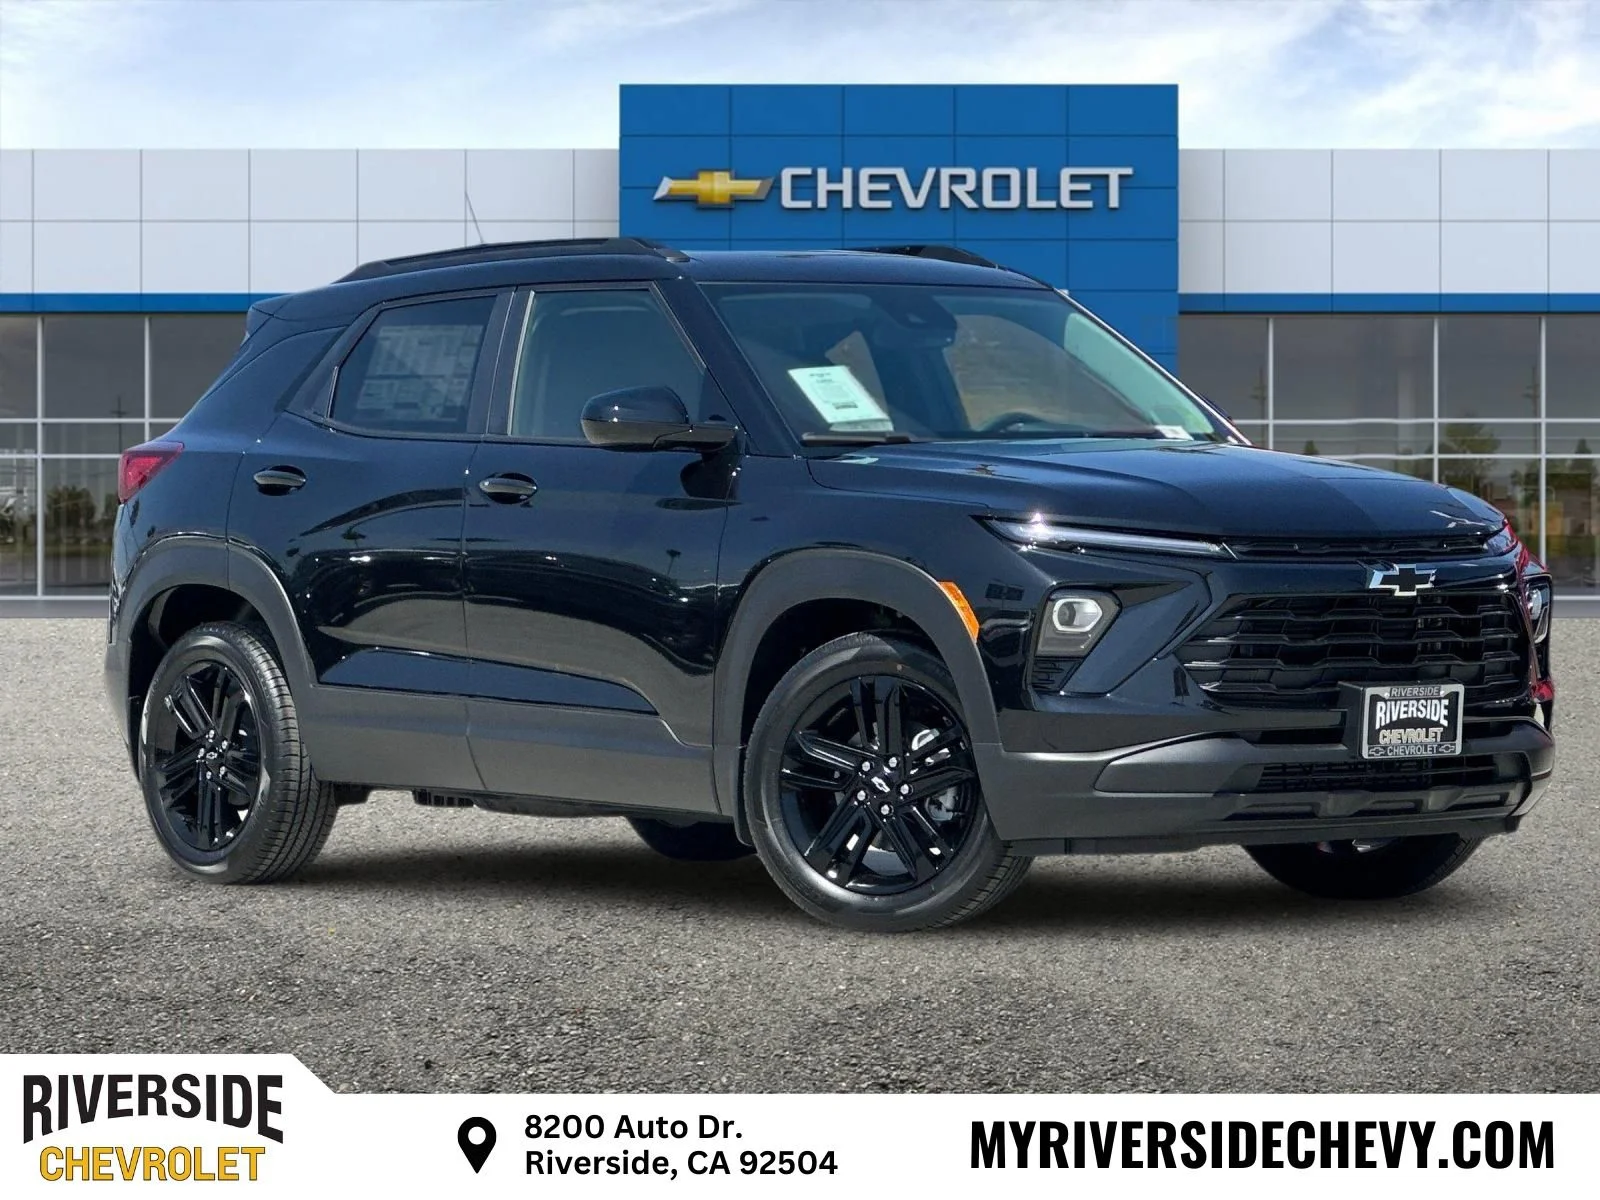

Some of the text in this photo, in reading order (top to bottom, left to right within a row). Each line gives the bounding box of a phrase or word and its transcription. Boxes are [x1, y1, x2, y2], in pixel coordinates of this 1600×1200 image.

[780, 166, 1134, 209] CHEVROLET
[1391, 687, 1440, 697] RIVERSIDE
[1375, 699, 1449, 730] RIVERSIDE
[1379, 727, 1443, 745] CHEVROLET
[1387, 744, 1438, 756] CHEVROLET
